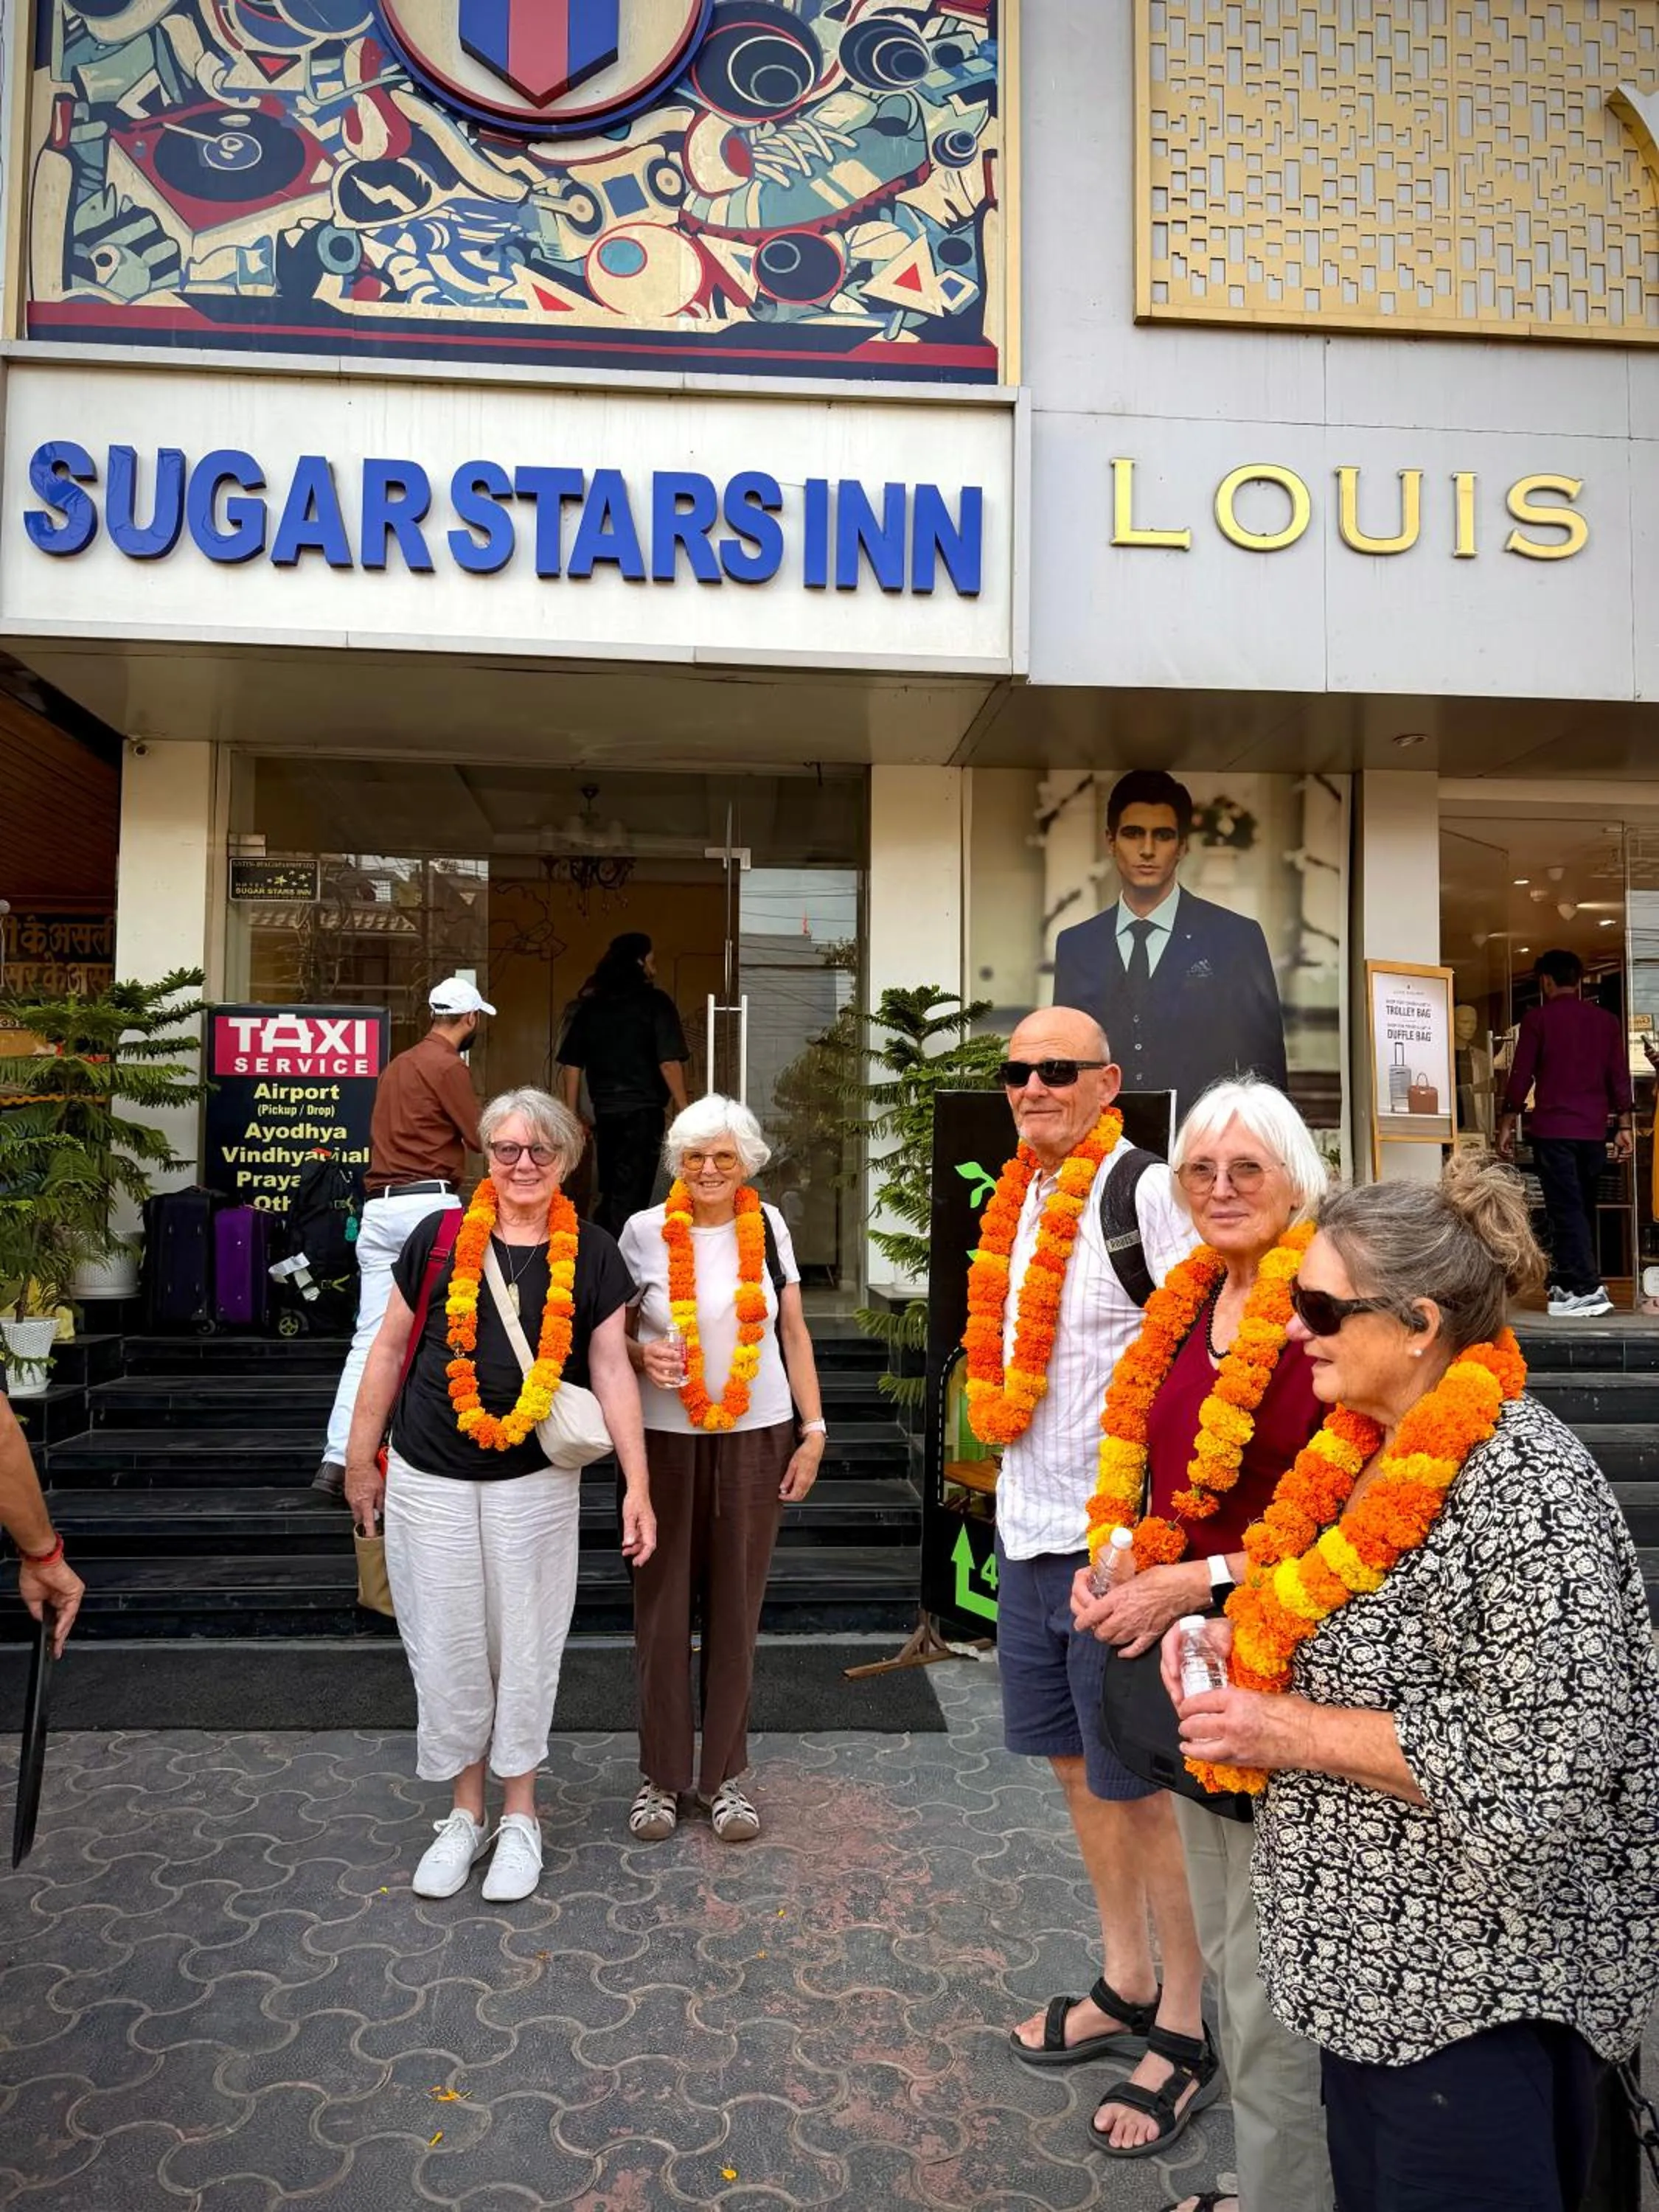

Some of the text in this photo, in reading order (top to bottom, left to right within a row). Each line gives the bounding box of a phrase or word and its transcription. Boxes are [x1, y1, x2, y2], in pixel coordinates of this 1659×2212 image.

[1109, 457, 1590, 562] LOUIS
[804, 478, 983, 597] INN
[1386, 1005, 1431, 1018] TROLLEY BAG
[228, 1014, 366, 1055] TAXI
[1416, 1030, 1431, 1042] BAG
[234, 1057, 369, 1075] SERVICE
[254, 1082, 340, 1104] Airport
[257, 1104, 297, 1118] (Pickup
[306, 1105, 335, 1119] Drop)
[244, 1121, 348, 1144] Ayodhya
